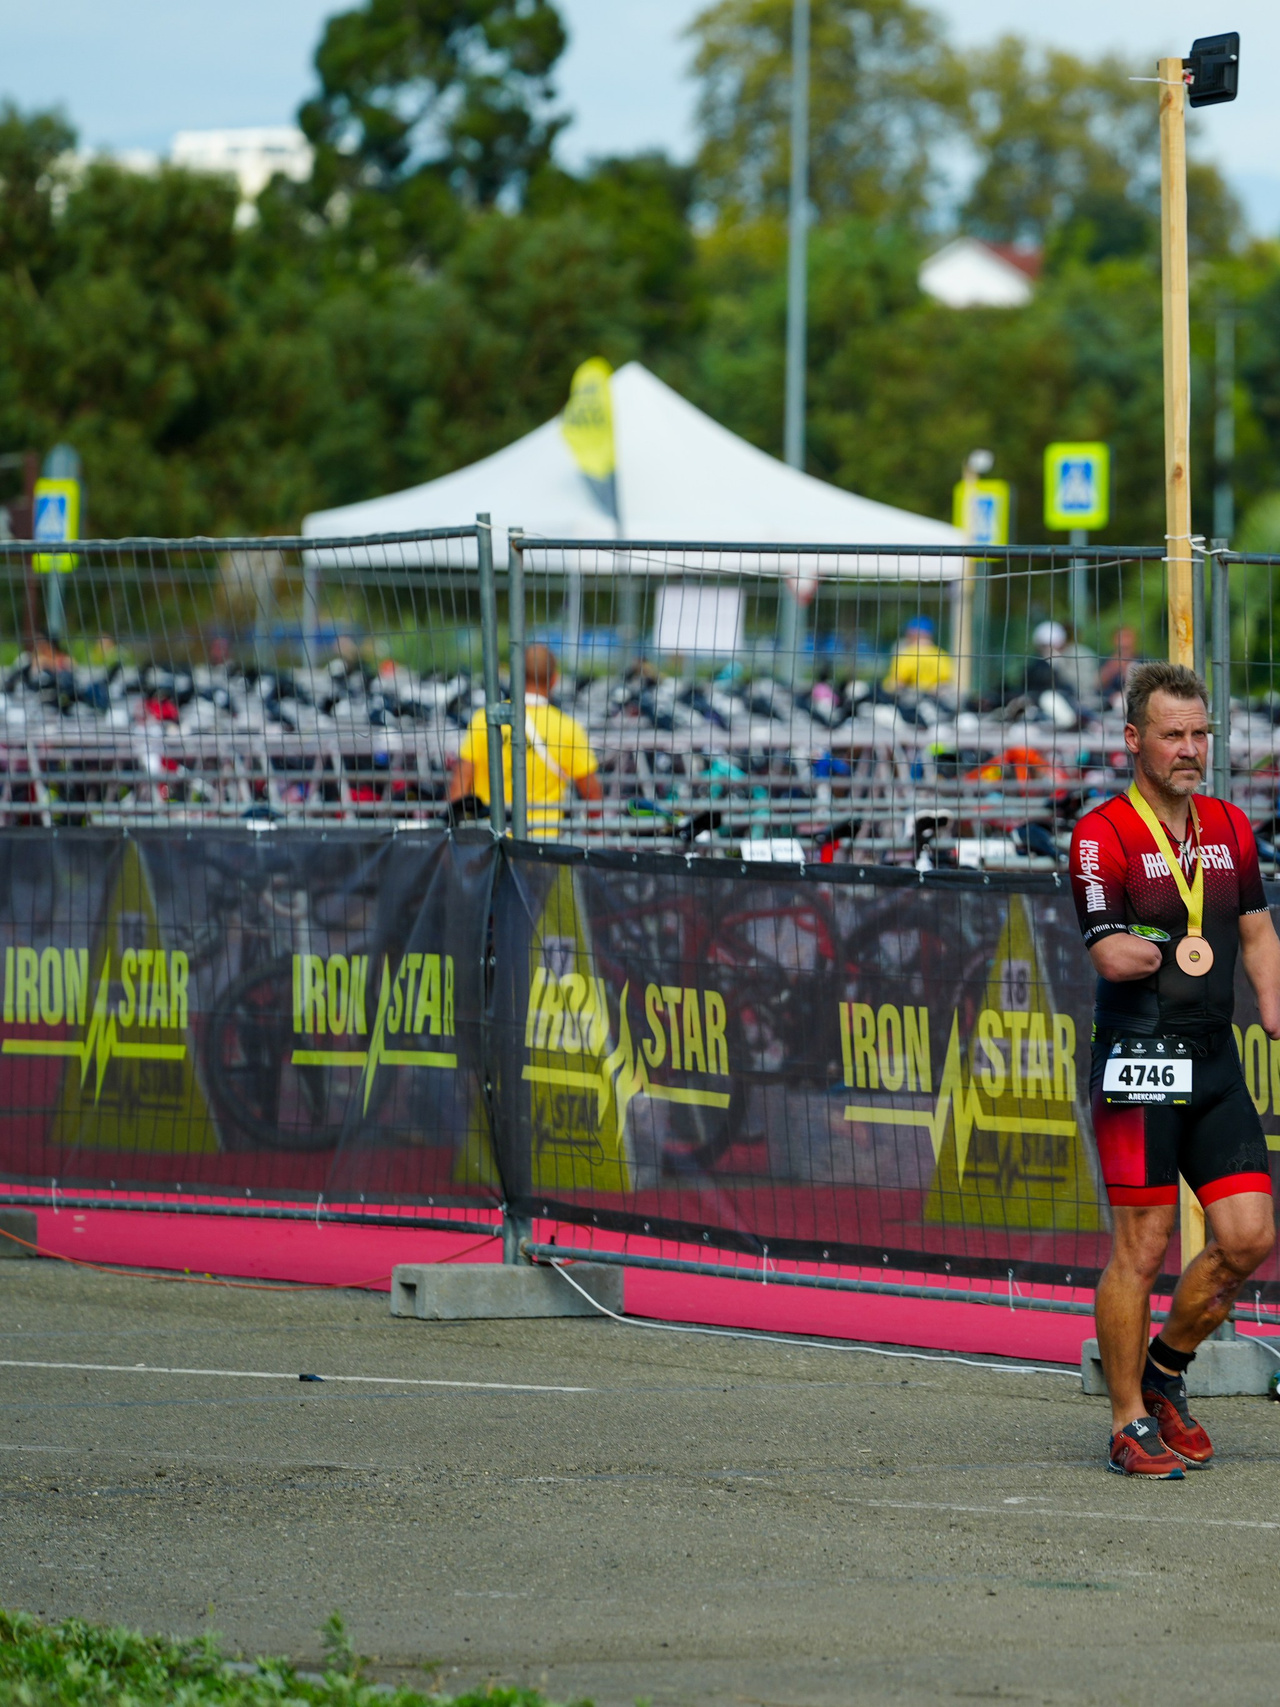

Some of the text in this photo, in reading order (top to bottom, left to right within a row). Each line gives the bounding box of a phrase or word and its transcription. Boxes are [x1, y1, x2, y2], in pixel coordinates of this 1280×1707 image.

[1079, 839, 1100, 871] STAR
[1141, 844, 1235, 879] IRO STAR
[3, 946, 189, 1030] IRON STAR
[292, 953, 456, 1037] IRON STAR
[643, 982, 729, 1076] STAR
[839, 1001, 1077, 1103] IRON STAR
[1118, 1064, 1175, 1087] 4746
[1128, 1093, 1167, 1102] АЛЕКСАНДР
